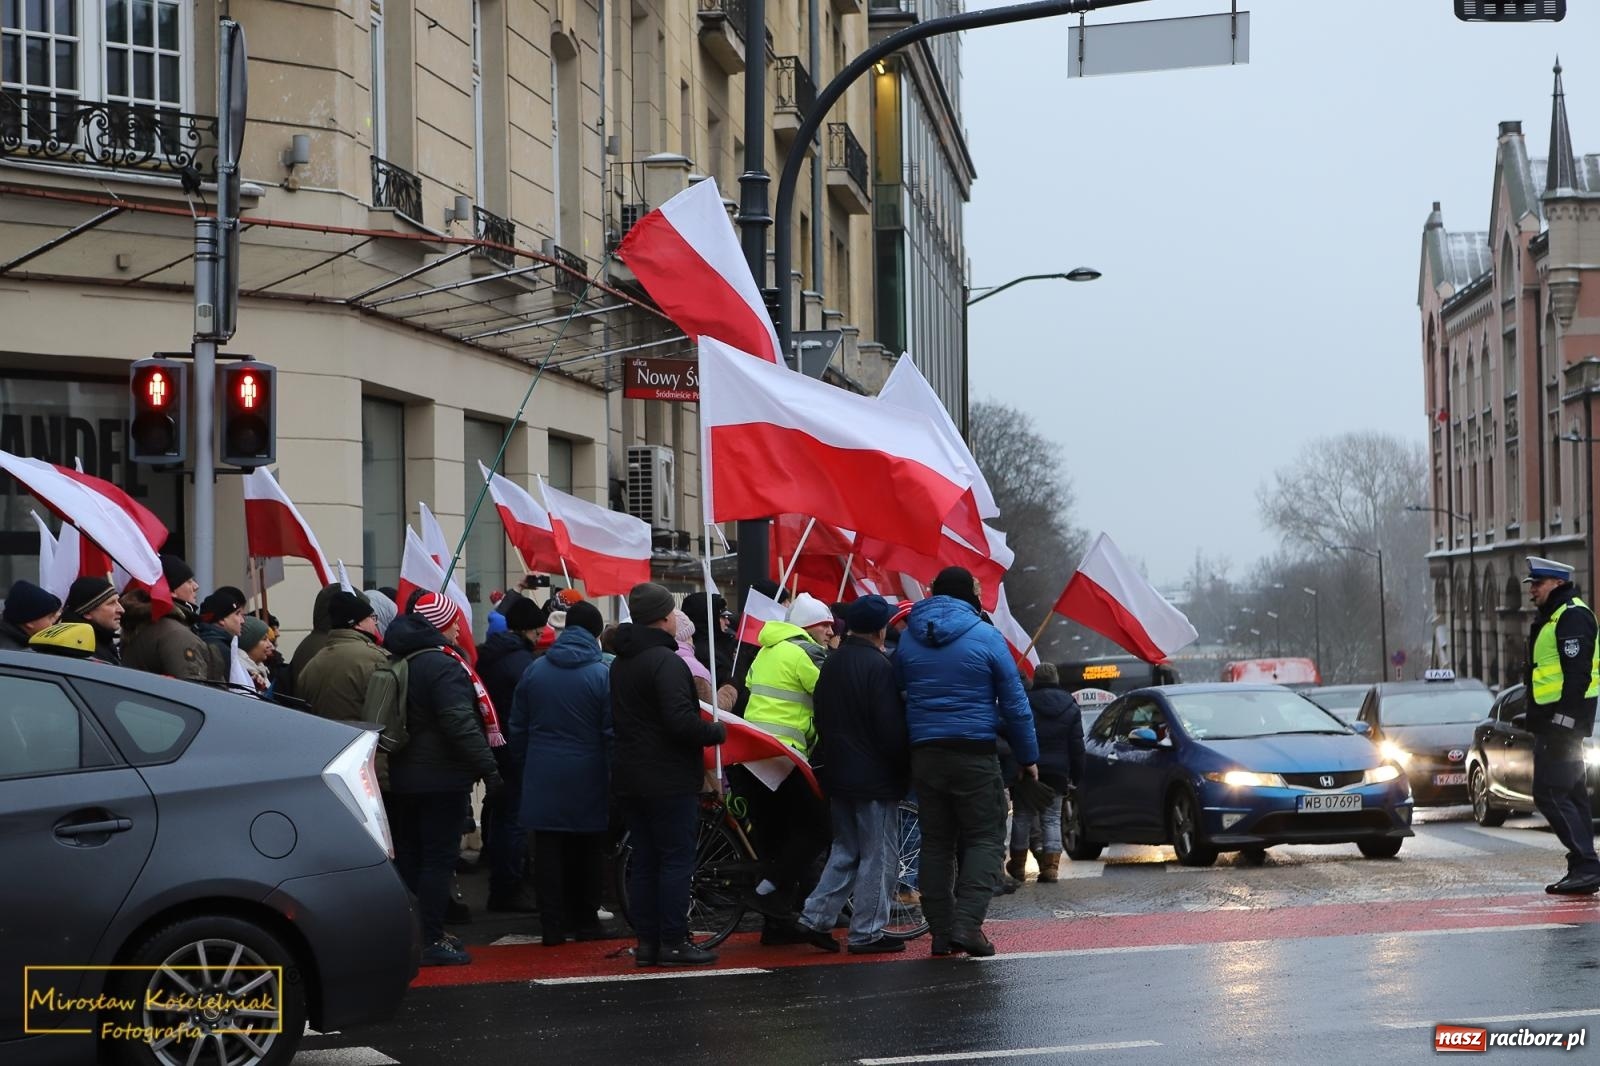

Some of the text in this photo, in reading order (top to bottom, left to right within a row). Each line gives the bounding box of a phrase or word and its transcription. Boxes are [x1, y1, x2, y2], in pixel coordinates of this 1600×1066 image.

[632, 359, 647, 367] ulica
[637, 368, 680, 390] Nowy
[656, 389, 691, 399] Śródmieście
[1430, 671, 1451, 679] TAXI
[1082, 692, 1096, 700] TAXI
[1304, 794, 1361, 809] WB 0769P
